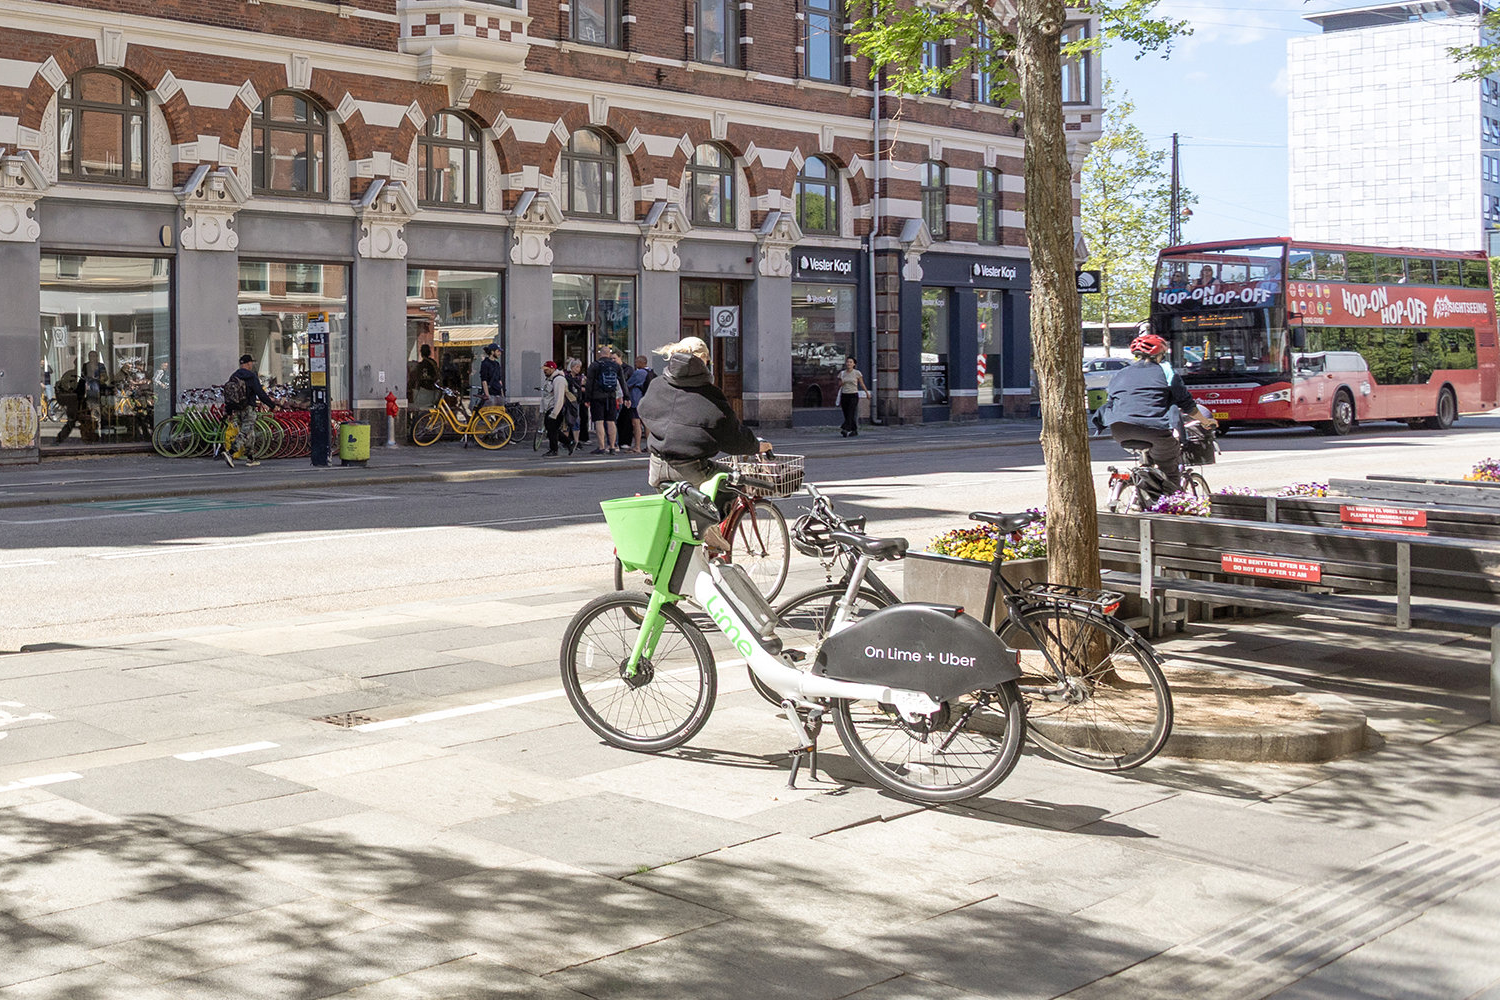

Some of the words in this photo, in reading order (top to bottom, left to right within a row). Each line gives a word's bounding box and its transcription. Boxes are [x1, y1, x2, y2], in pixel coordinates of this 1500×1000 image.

[810, 258, 833, 271] Vester
[834, 259, 851, 274] Kopi
[981, 265, 1001, 278] Vester
[1001, 266, 1016, 280] Kopi
[1158, 285, 1215, 305] HOP-ON
[1202, 288, 1271, 306] HOP-OFF
[1341, 286, 1388, 317] HOP-ON
[1381, 297, 1428, 325] HOP-OFF
[1450, 302, 1488, 314] SIGHTSEEING
[706, 595, 753, 657] Lime
[864, 645, 884, 659] On
[888, 647, 921, 662] Lime
[925, 653, 935, 662] +
[939, 652, 976, 667] Uber
